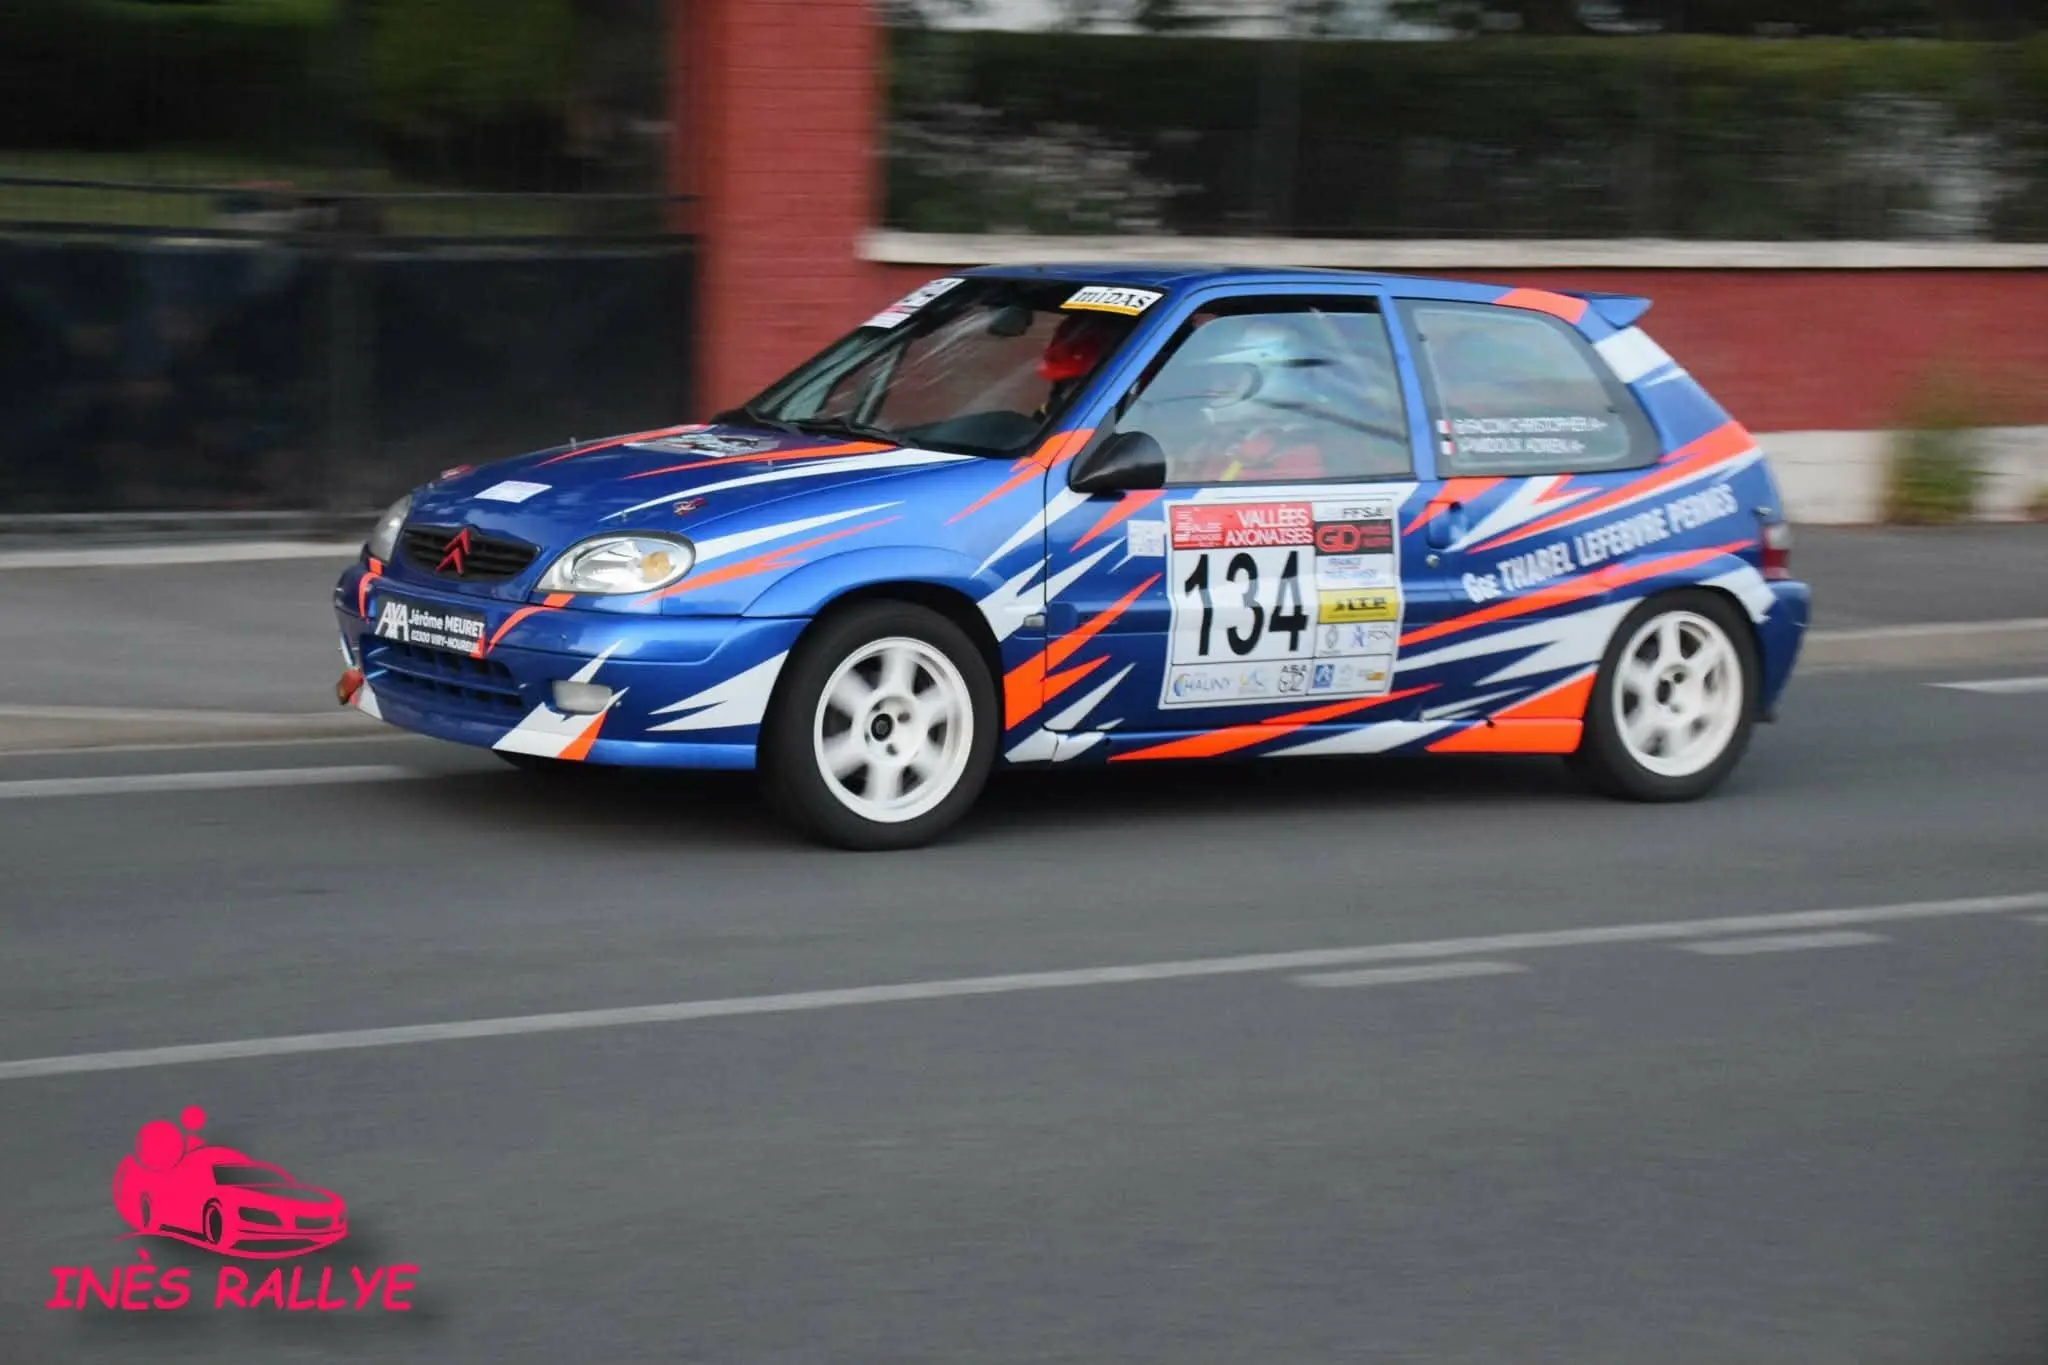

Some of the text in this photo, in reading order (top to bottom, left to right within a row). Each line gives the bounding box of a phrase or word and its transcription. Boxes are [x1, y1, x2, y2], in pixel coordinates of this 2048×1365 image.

[1236, 504, 1310, 528] VALLÉES
[1224, 527, 1314, 546] AXONAISES
[1185, 551, 1310, 656] 134
[445, 615, 485, 638] MEURET
